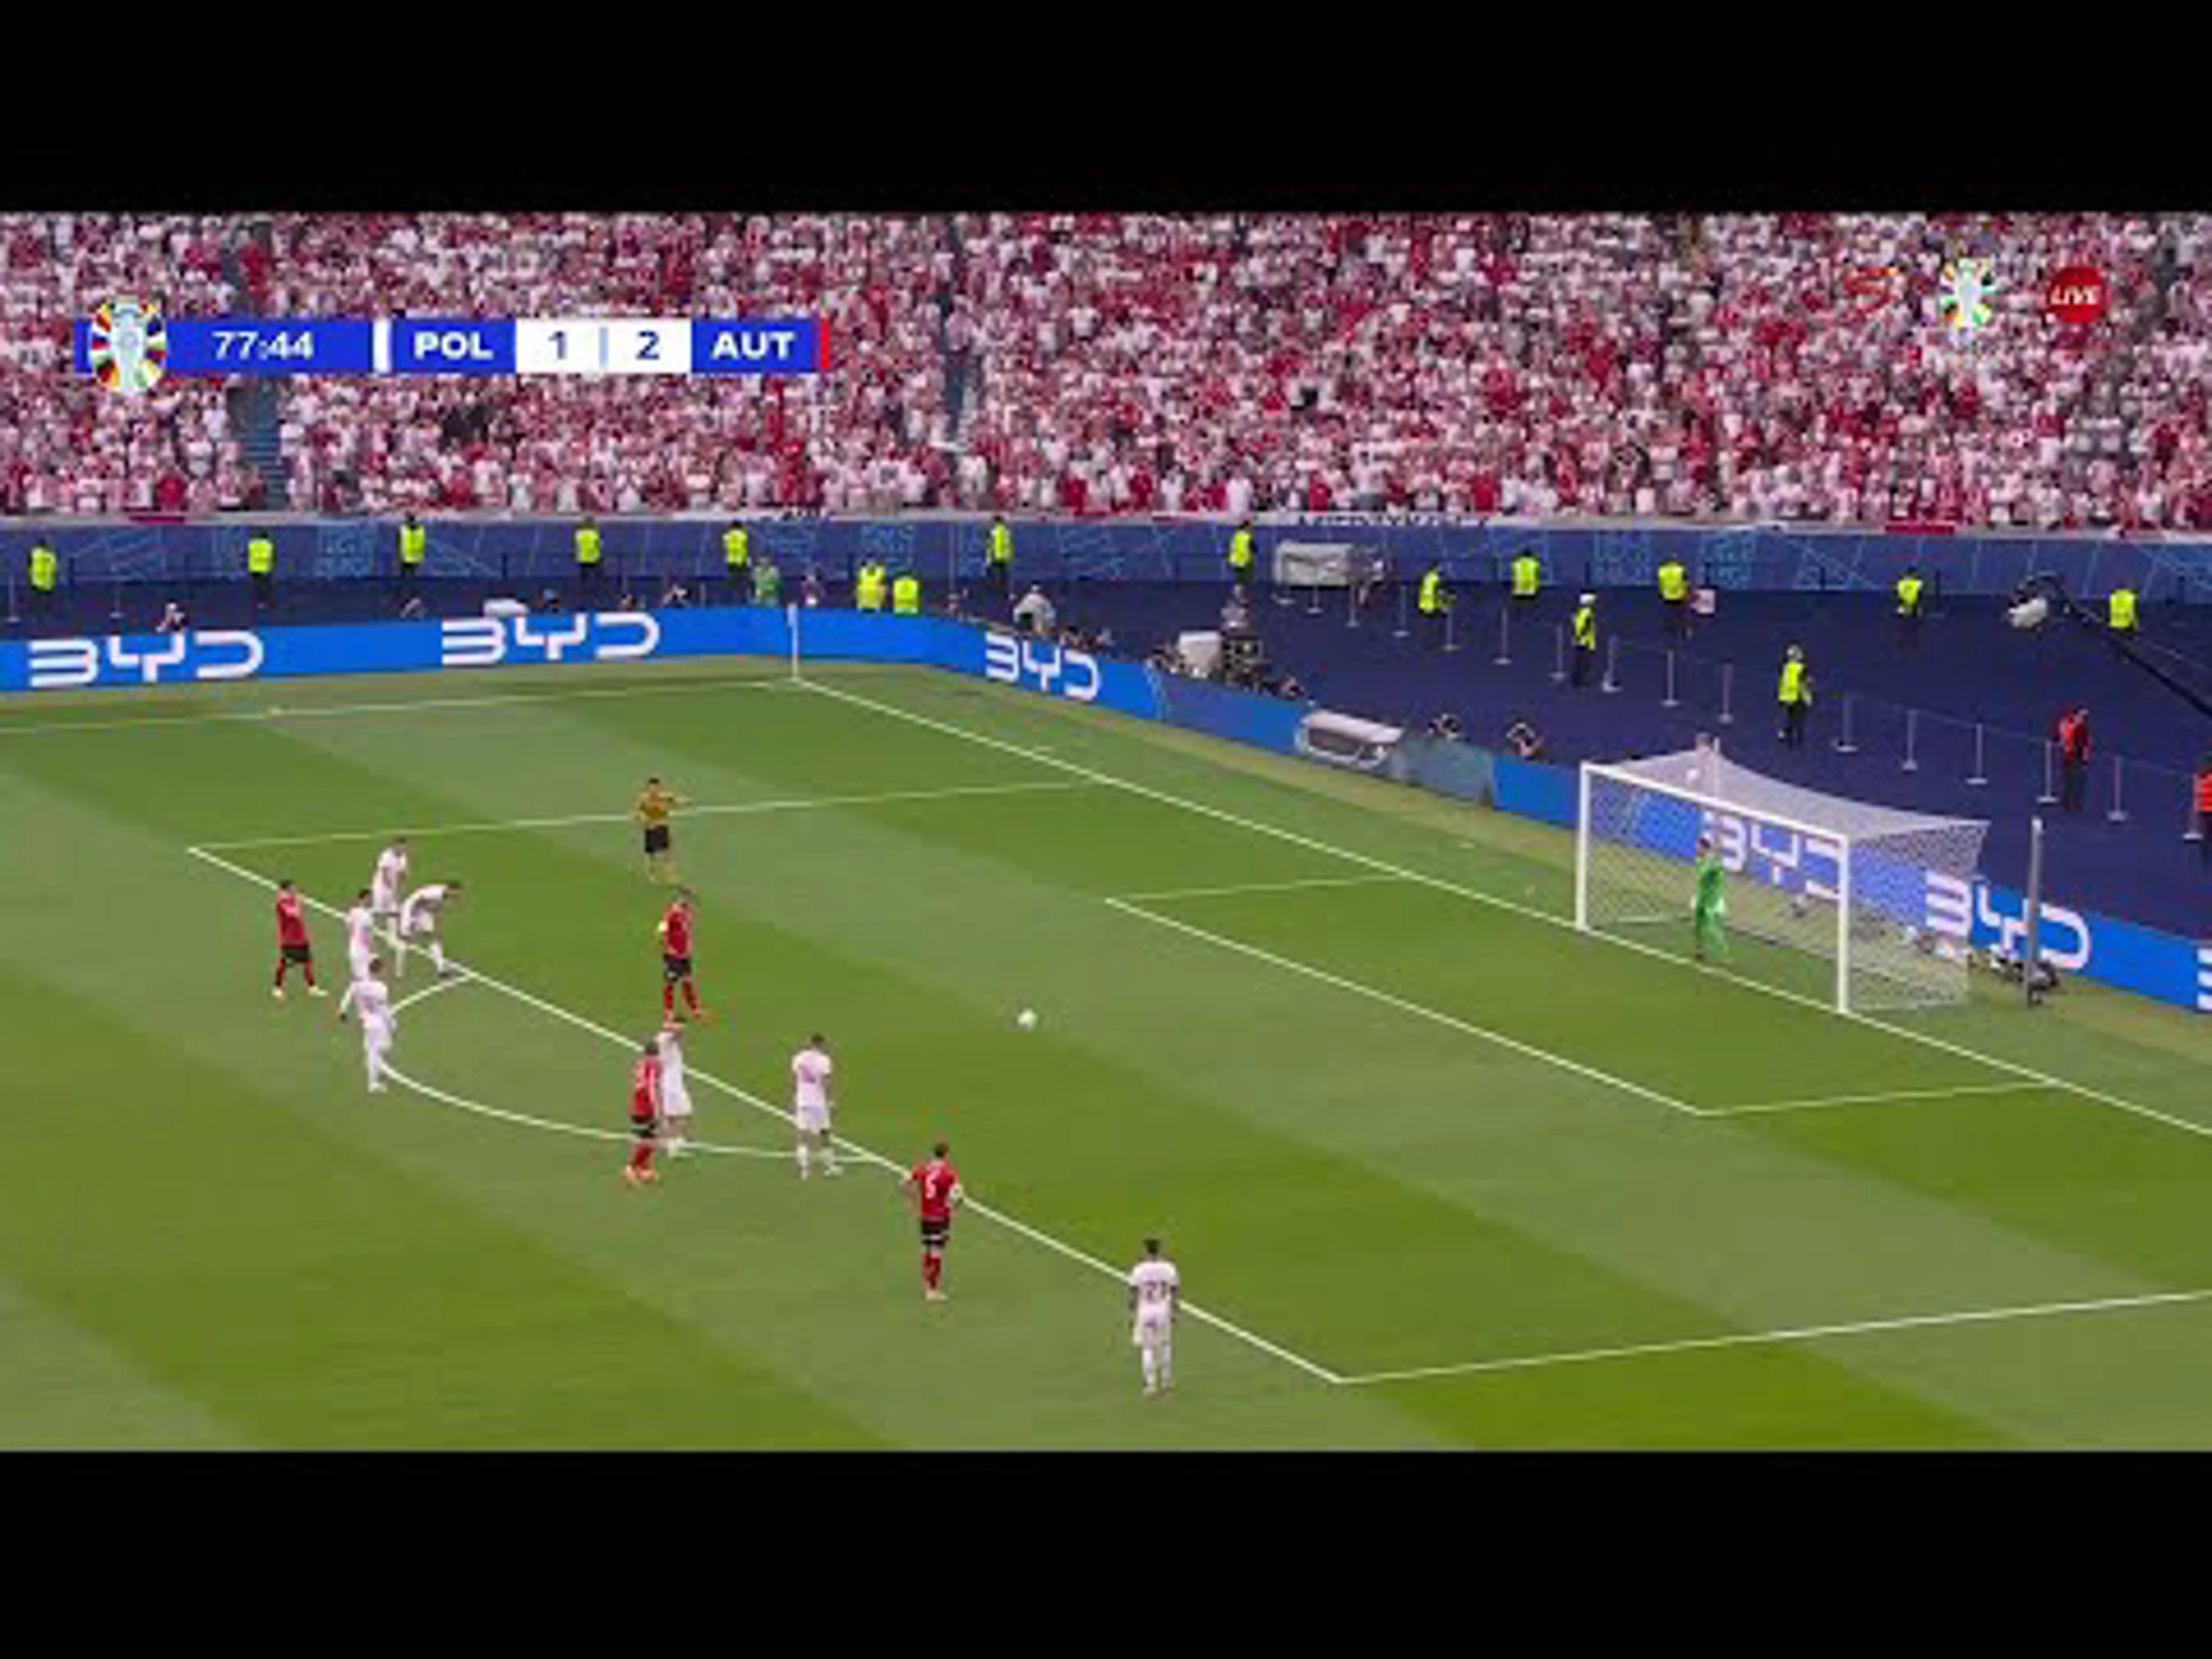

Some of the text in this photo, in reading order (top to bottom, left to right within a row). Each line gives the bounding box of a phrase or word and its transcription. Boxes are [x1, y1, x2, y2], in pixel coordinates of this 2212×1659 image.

[28, 630, 264, 688] BYD
[442, 612, 660, 665] BYD
[984, 631, 1101, 701] BYD
[1925, 870, 2093, 969] BYD
